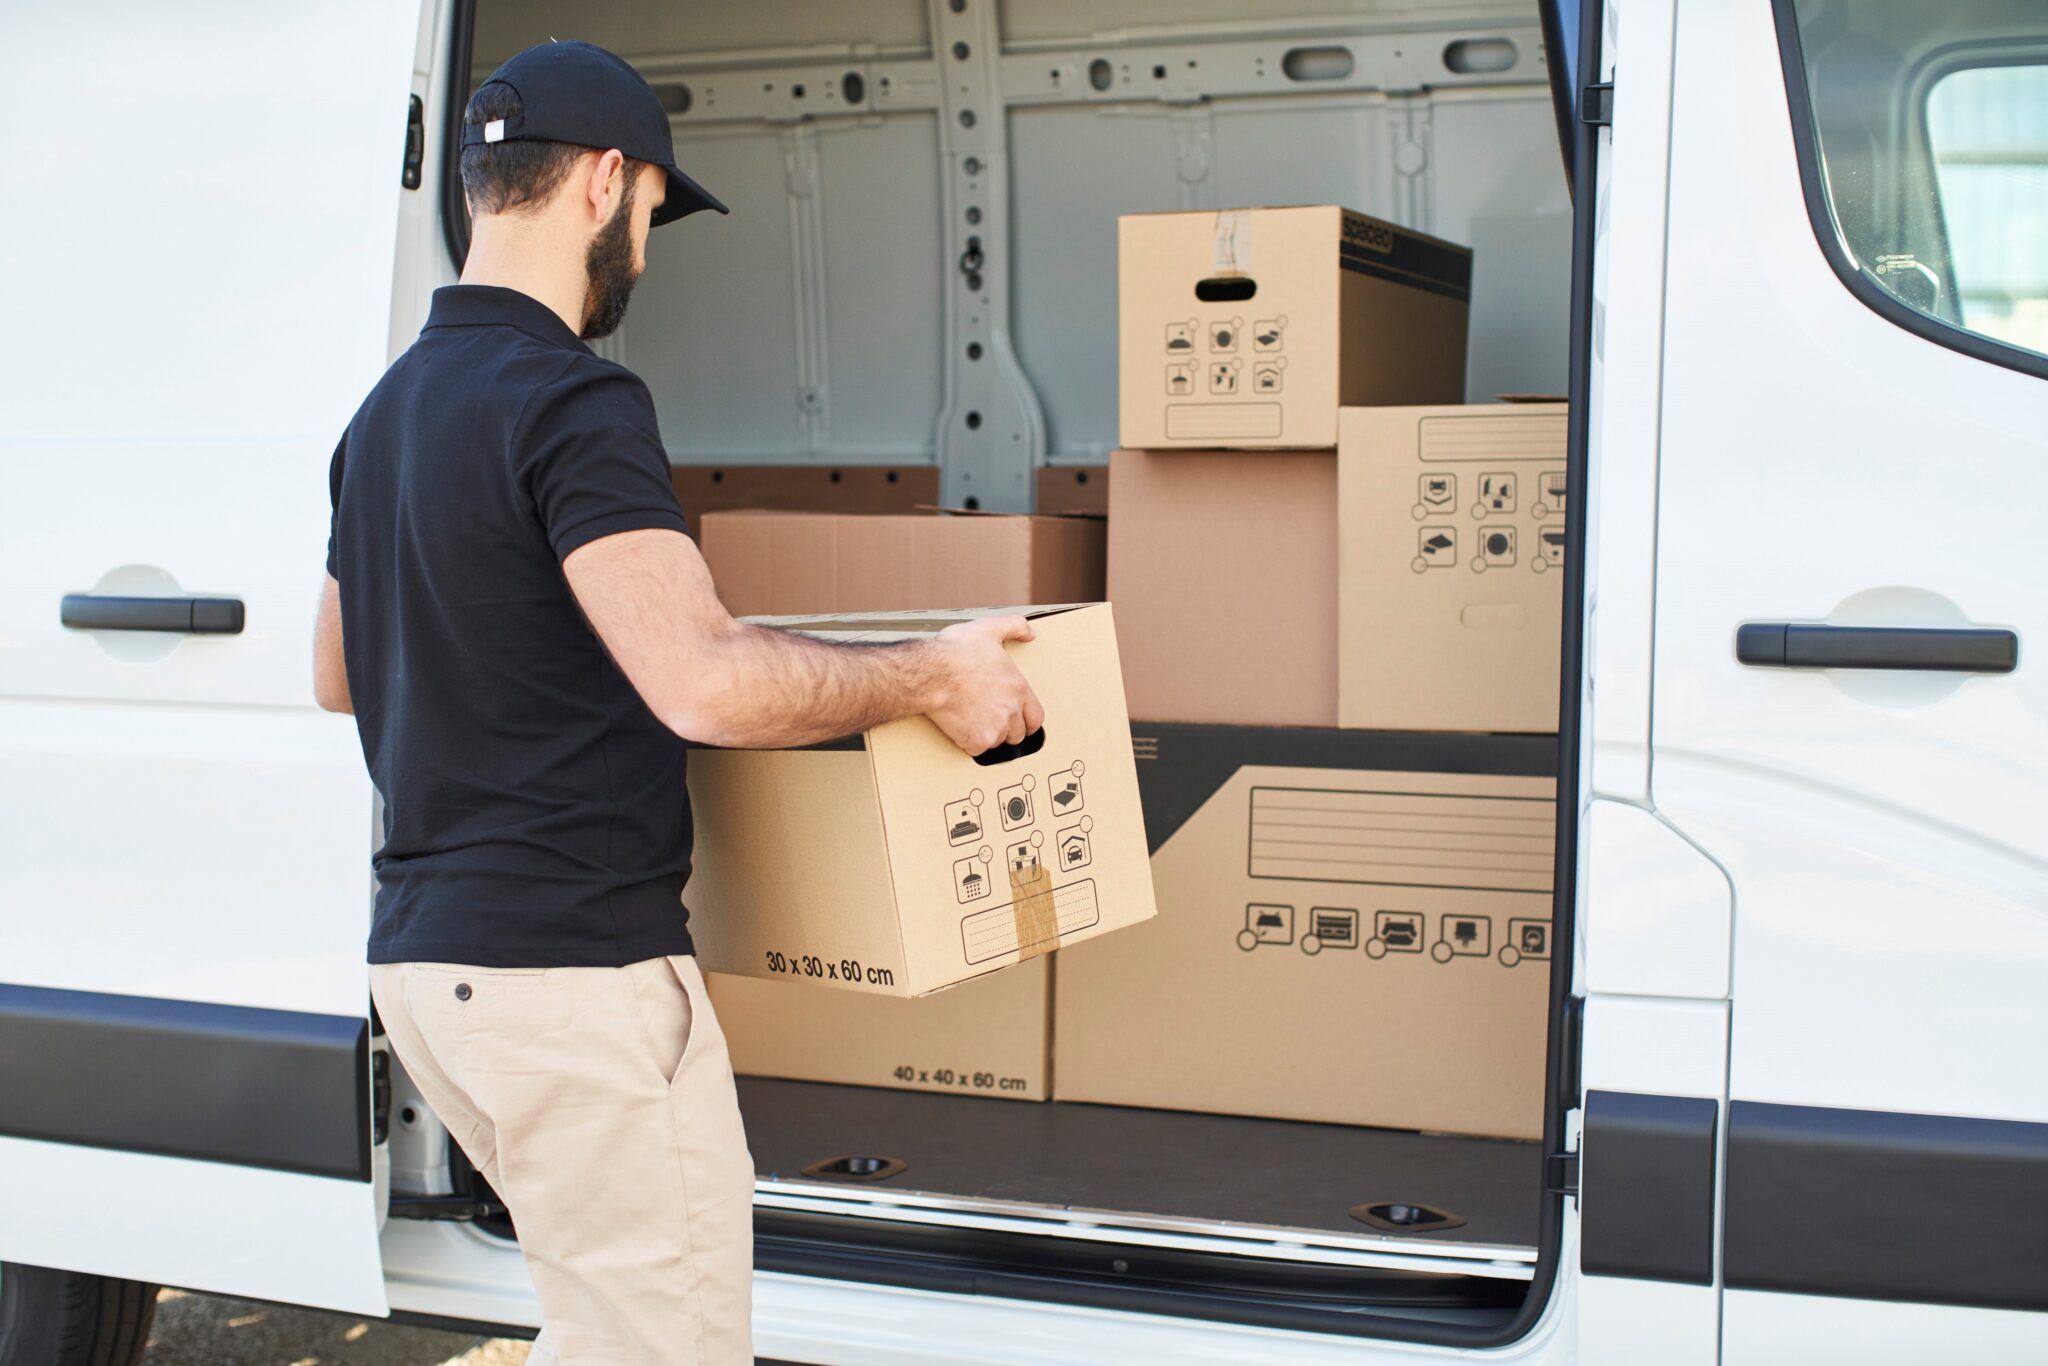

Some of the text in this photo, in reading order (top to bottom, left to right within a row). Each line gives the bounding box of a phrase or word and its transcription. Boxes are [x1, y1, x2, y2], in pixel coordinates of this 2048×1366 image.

[766, 950, 894, 986] 30 x 30 x 60 cm
[893, 1066, 1027, 1091] 40 x 40 x 60 cm
